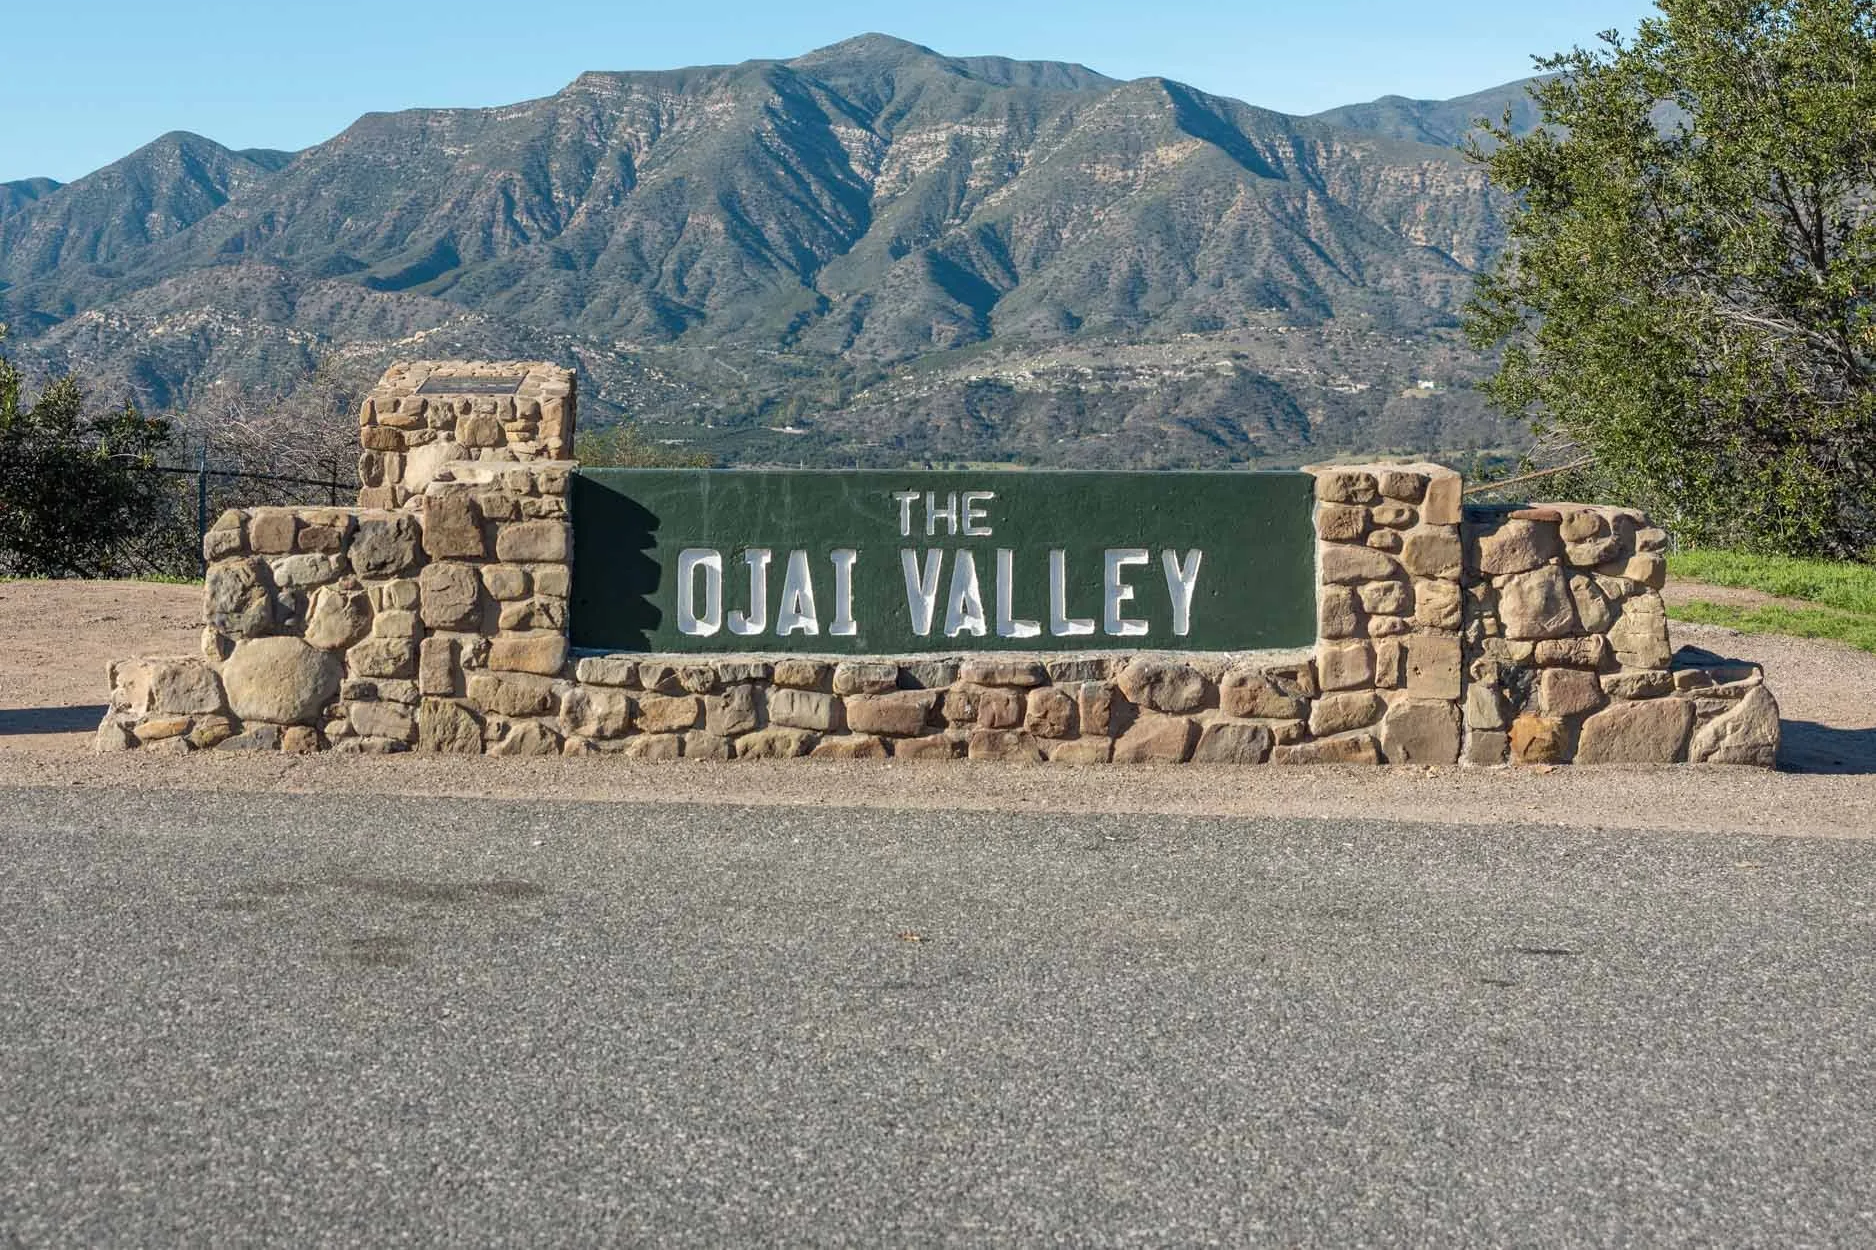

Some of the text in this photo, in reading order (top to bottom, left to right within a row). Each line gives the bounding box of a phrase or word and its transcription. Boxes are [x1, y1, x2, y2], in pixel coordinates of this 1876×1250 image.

[895, 490, 995, 537] THE
[677, 548, 1203, 639] OJAI VALLEY
